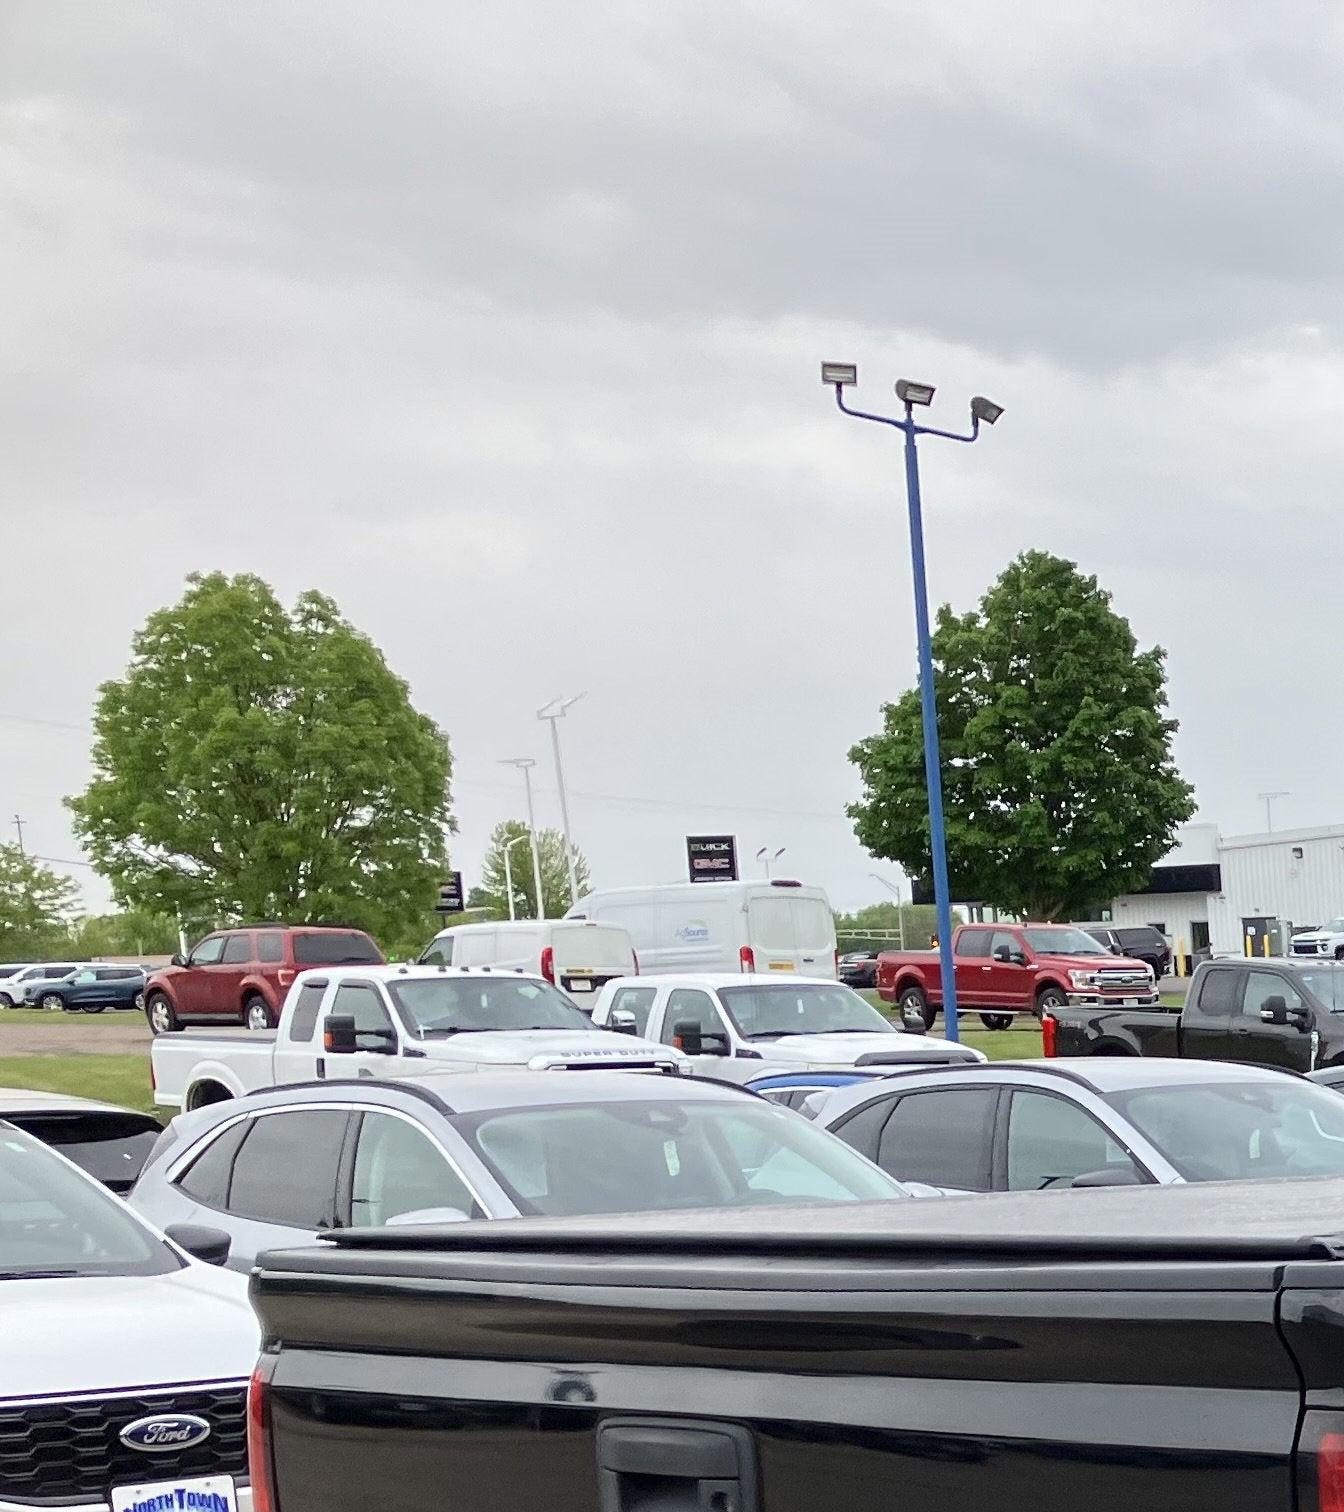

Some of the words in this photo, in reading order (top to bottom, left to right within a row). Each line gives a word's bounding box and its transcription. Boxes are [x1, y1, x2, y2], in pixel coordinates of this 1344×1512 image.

[690, 843, 731, 851] BUICK
[560, 1050, 612, 1058] SUPER
[143, 1421, 192, 1444] Ford
